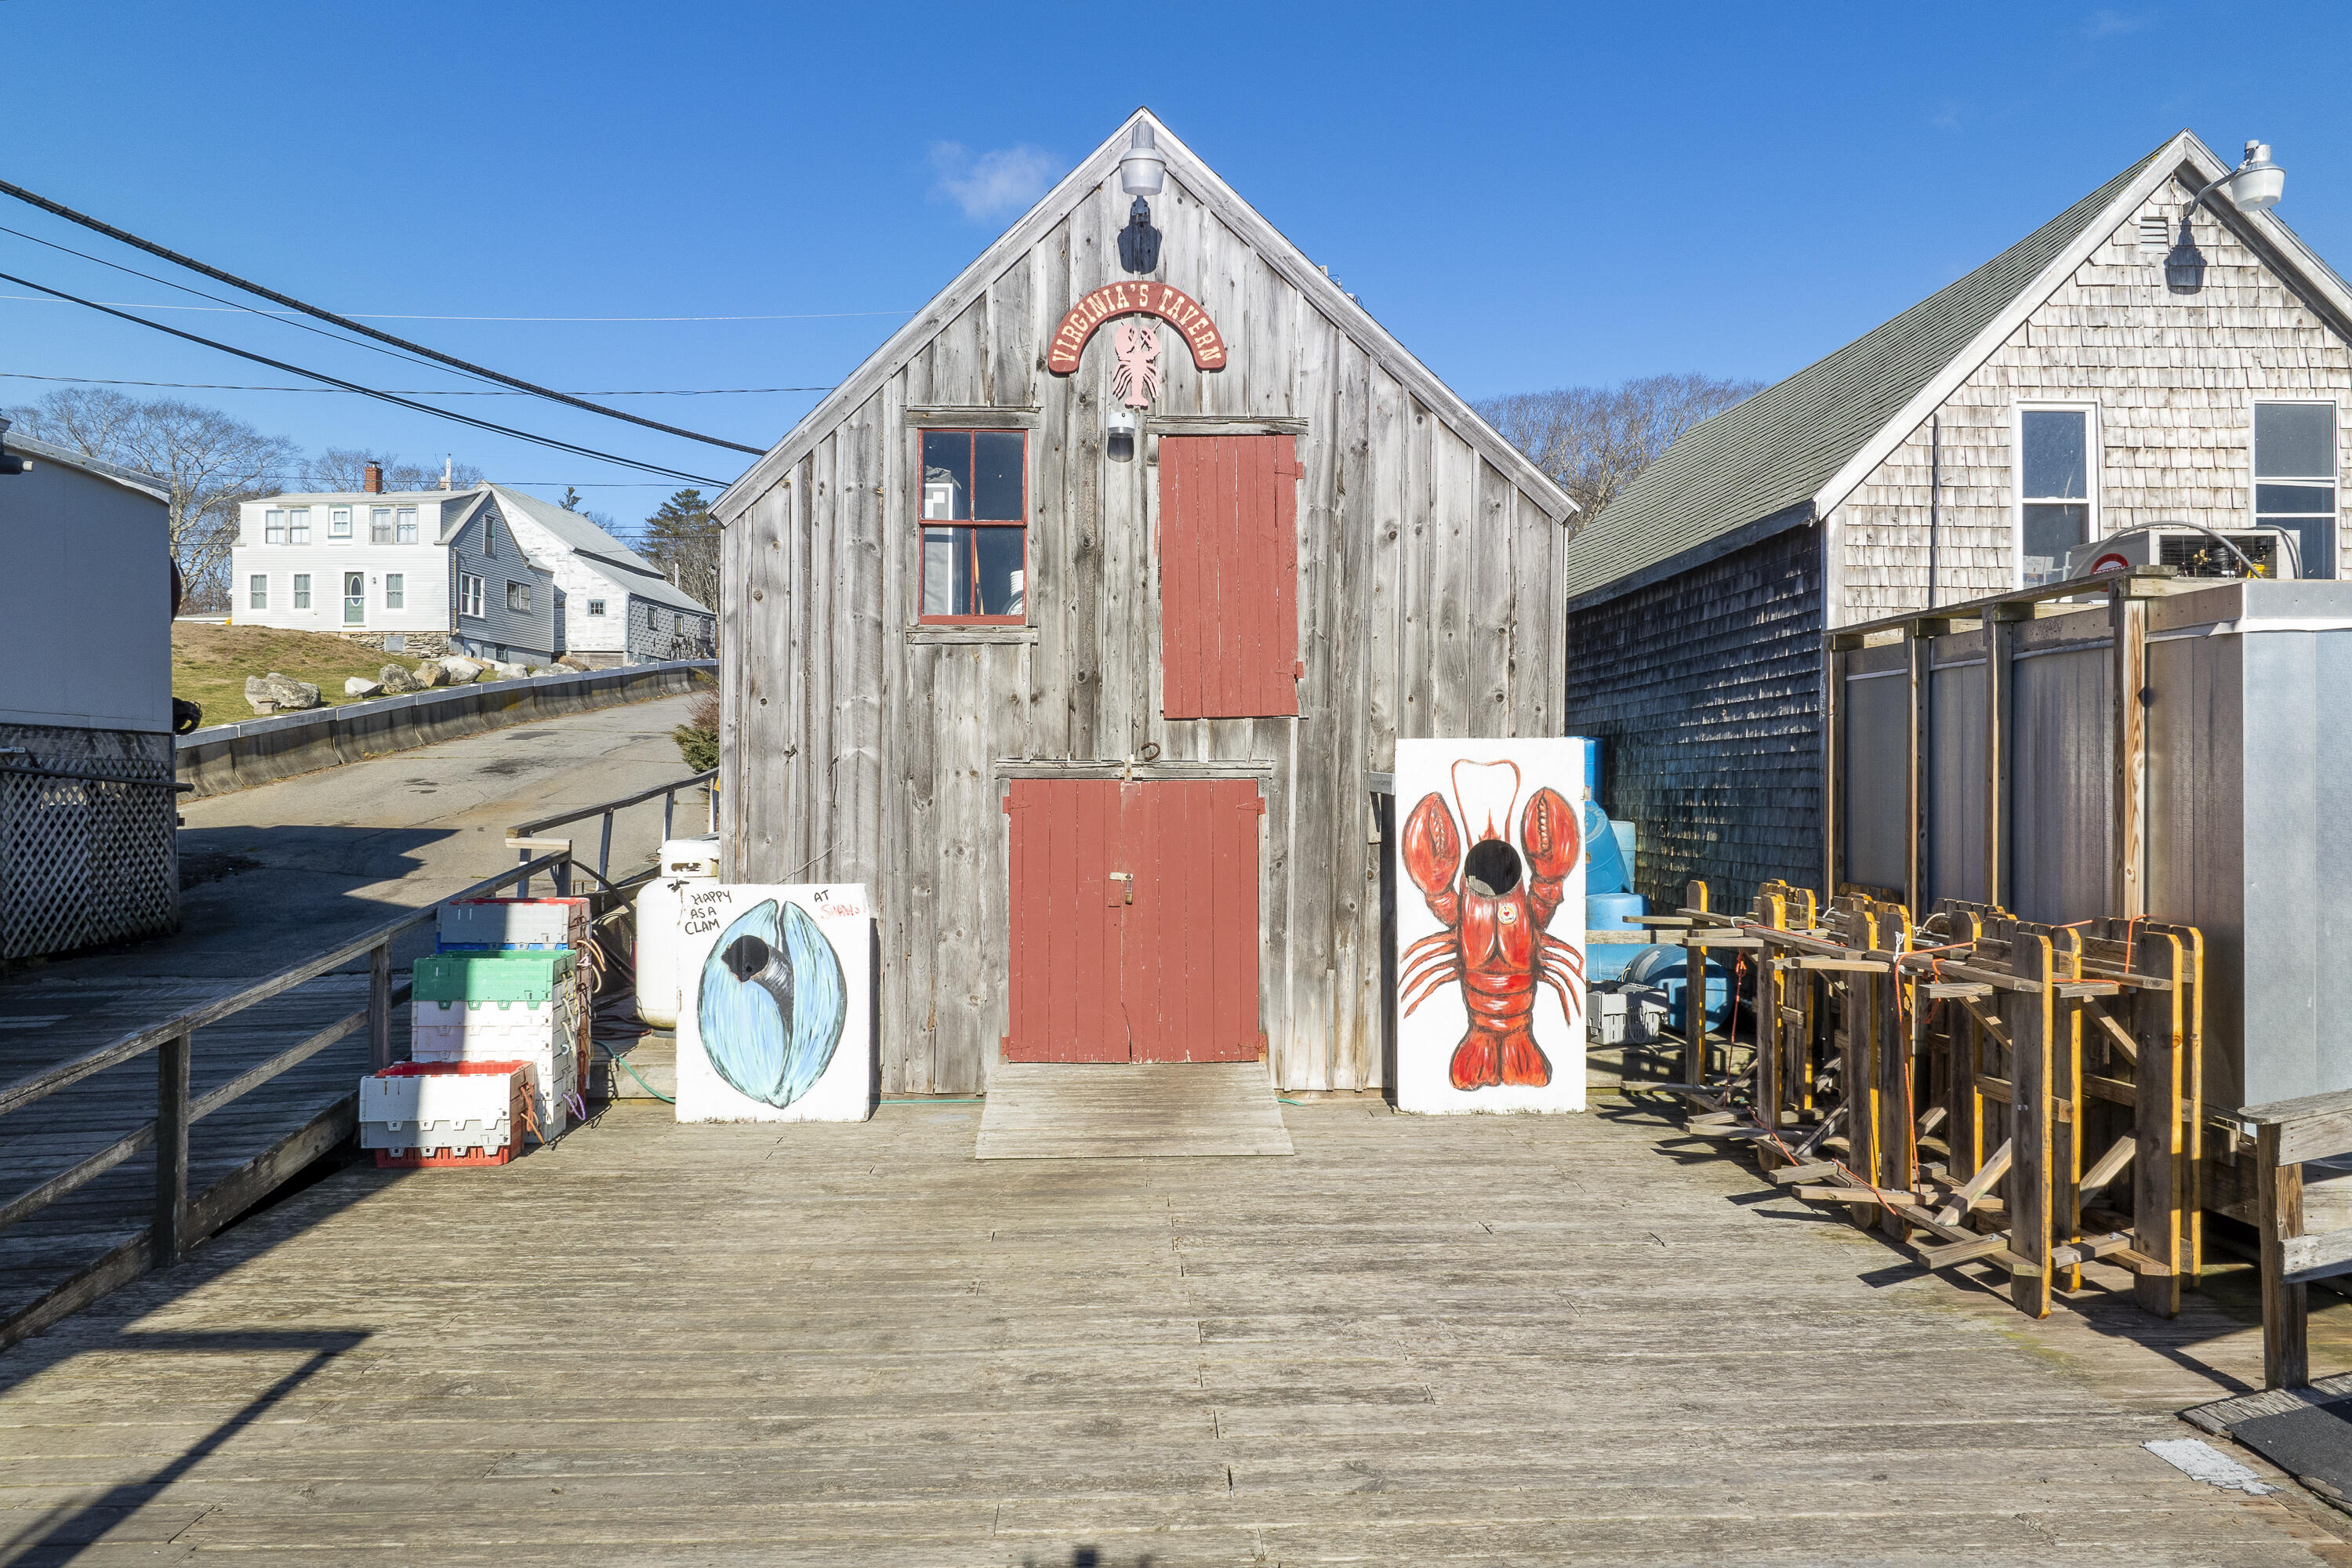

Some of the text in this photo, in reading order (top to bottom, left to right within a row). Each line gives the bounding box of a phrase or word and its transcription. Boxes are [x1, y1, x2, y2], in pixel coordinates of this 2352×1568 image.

[1051, 284, 1221, 362] VIRGINIA'S TAVERN
[691, 890, 732, 906] HAPPY
[814, 889, 829, 902] AT
[691, 906, 717, 920] AS A
[684, 918, 720, 935] CLAM
